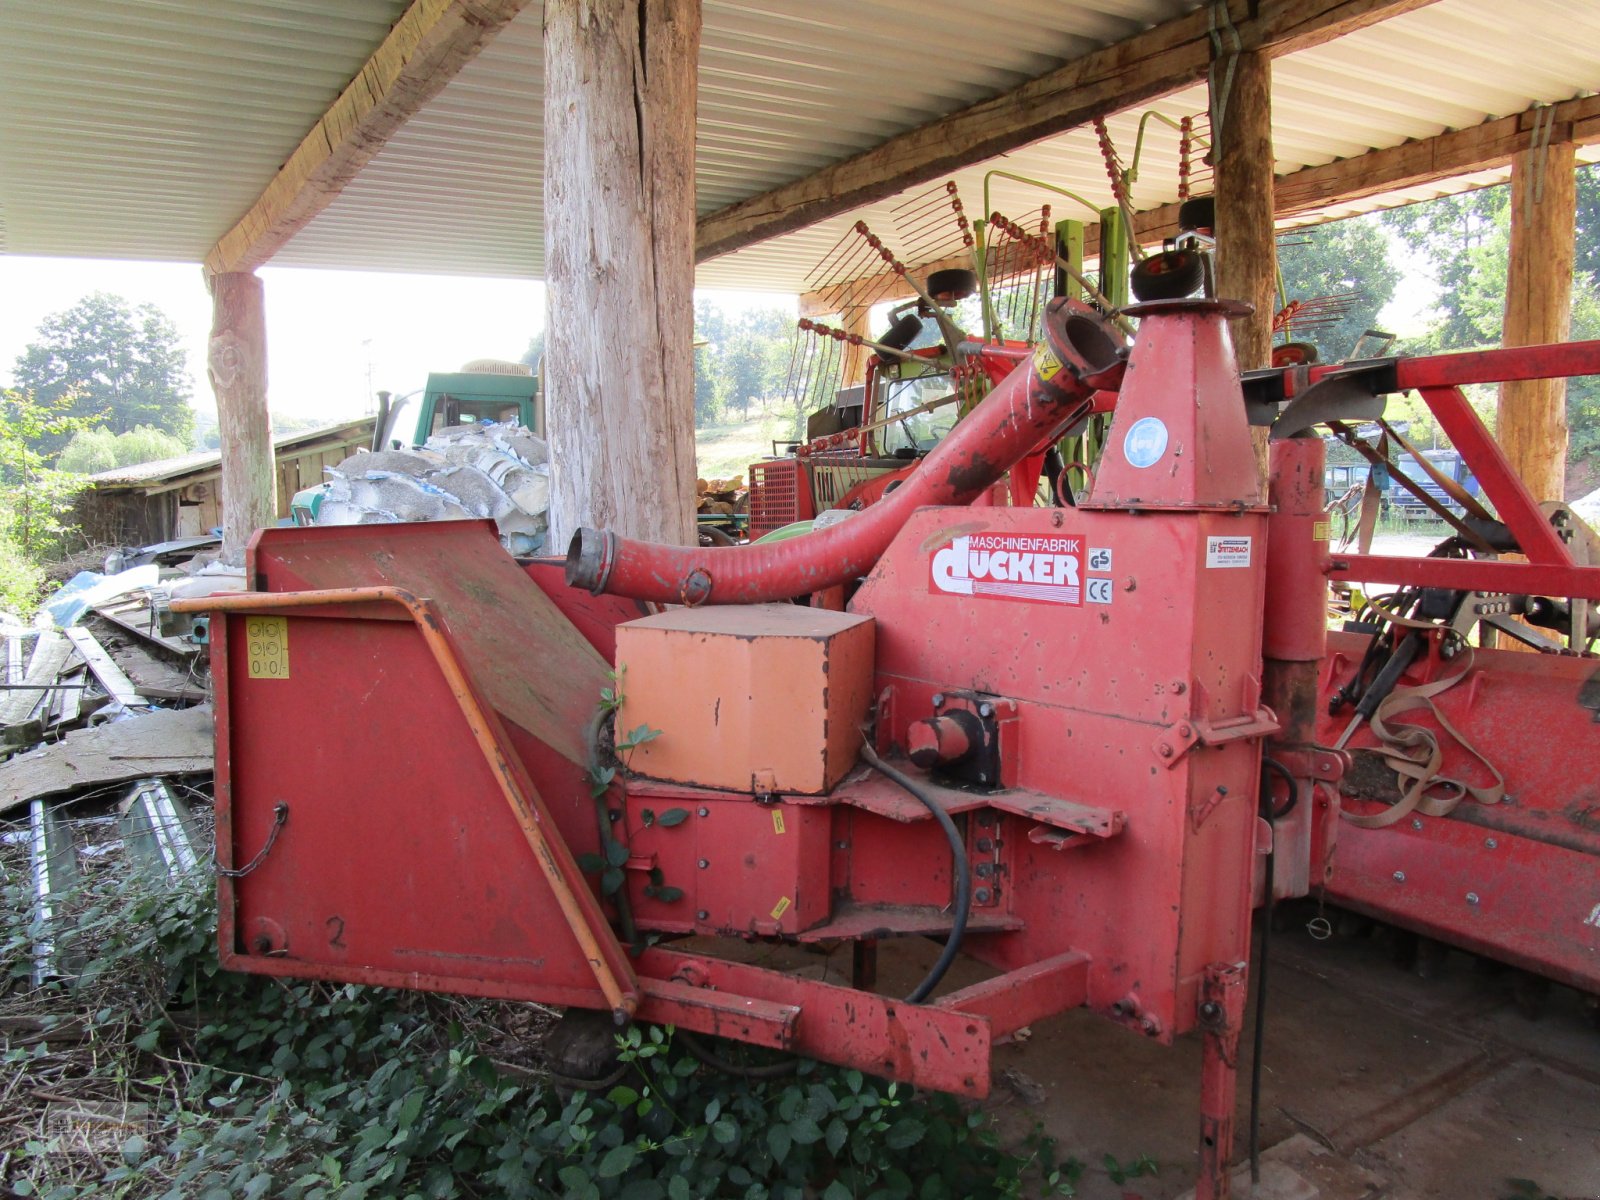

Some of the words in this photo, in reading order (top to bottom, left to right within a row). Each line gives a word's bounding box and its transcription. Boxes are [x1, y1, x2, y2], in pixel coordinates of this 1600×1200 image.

[969, 536, 1079, 553] MASCHINENFABRIK
[1090, 550, 1110, 569] GS
[1089, 581, 1109, 601] CE
